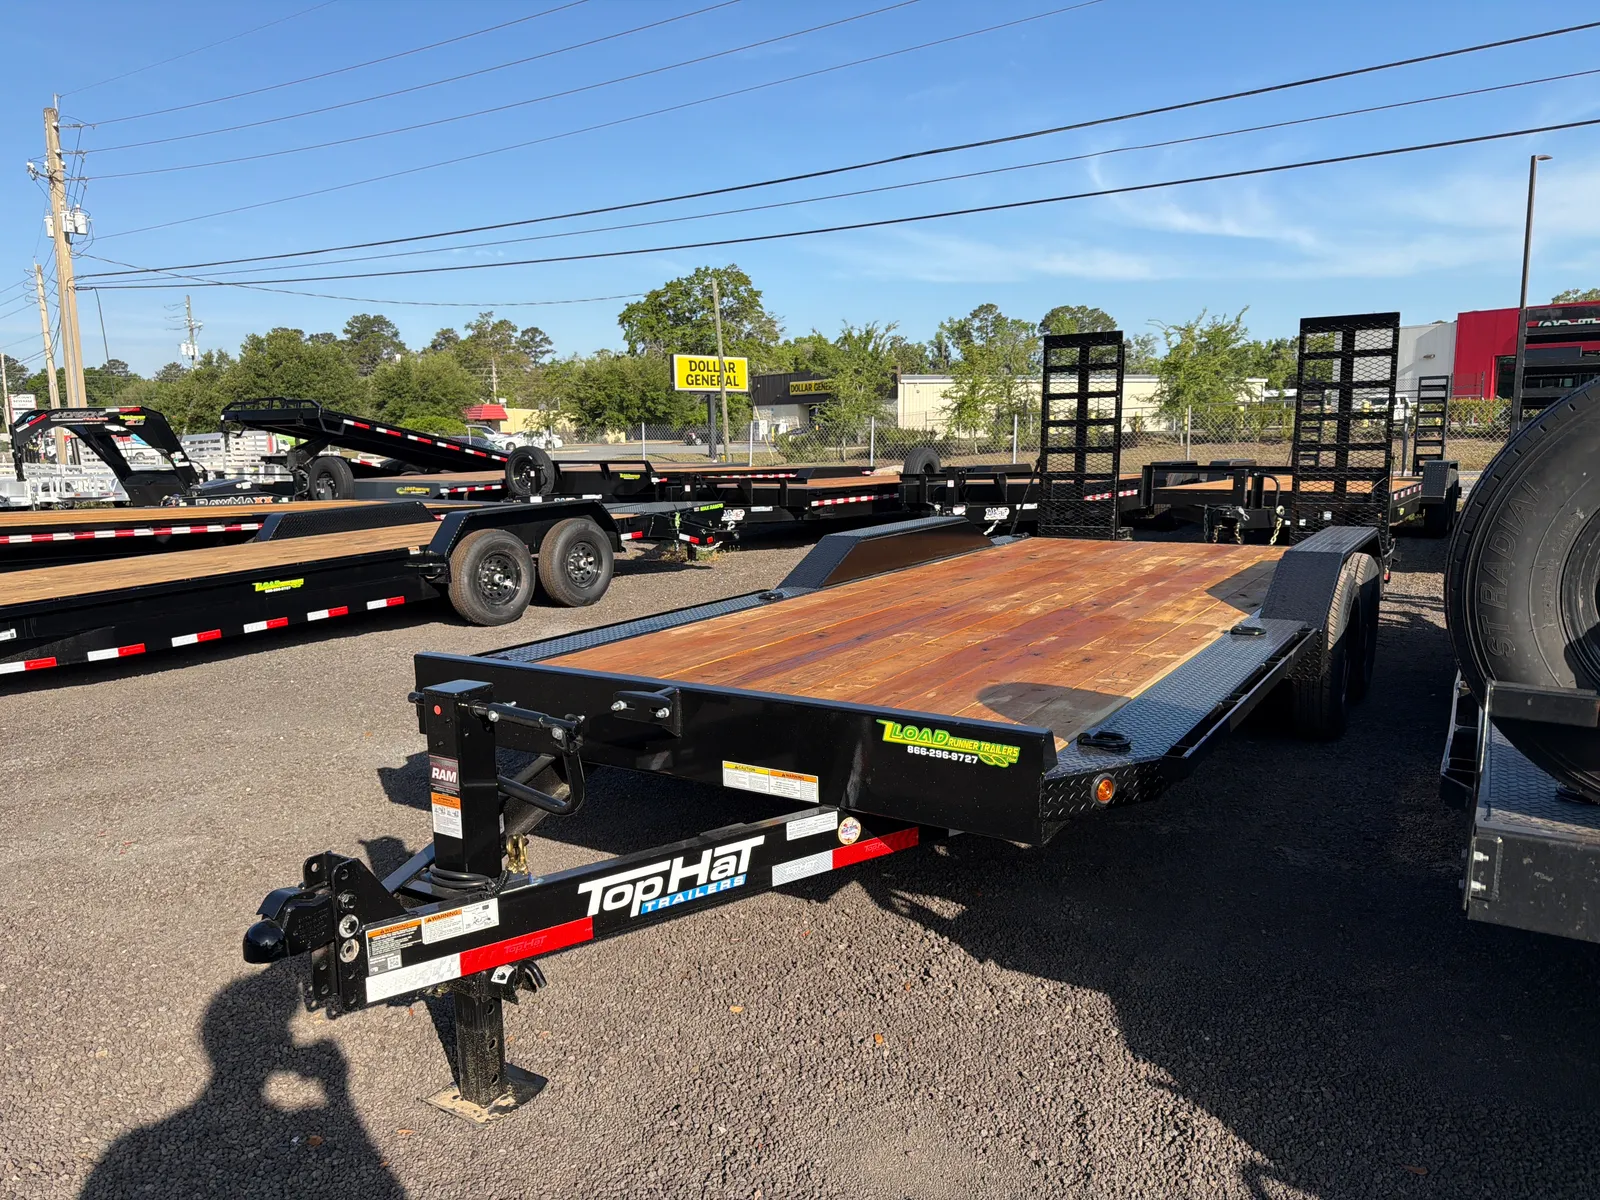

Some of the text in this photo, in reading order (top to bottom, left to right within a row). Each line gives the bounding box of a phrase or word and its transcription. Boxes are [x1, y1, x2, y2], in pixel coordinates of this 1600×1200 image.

[790, 383, 812, 392] DOLLAR
[1480, 479, 1545, 658] ST RADIAL
[891, 723, 1020, 757] LOAD RUNNER TRAILERS
[907, 745, 978, 764] 866-296-9727
[431, 766, 457, 783] RAM
[645, 874, 746, 912] TRAILERS
[431, 910, 458, 921] WARNING
